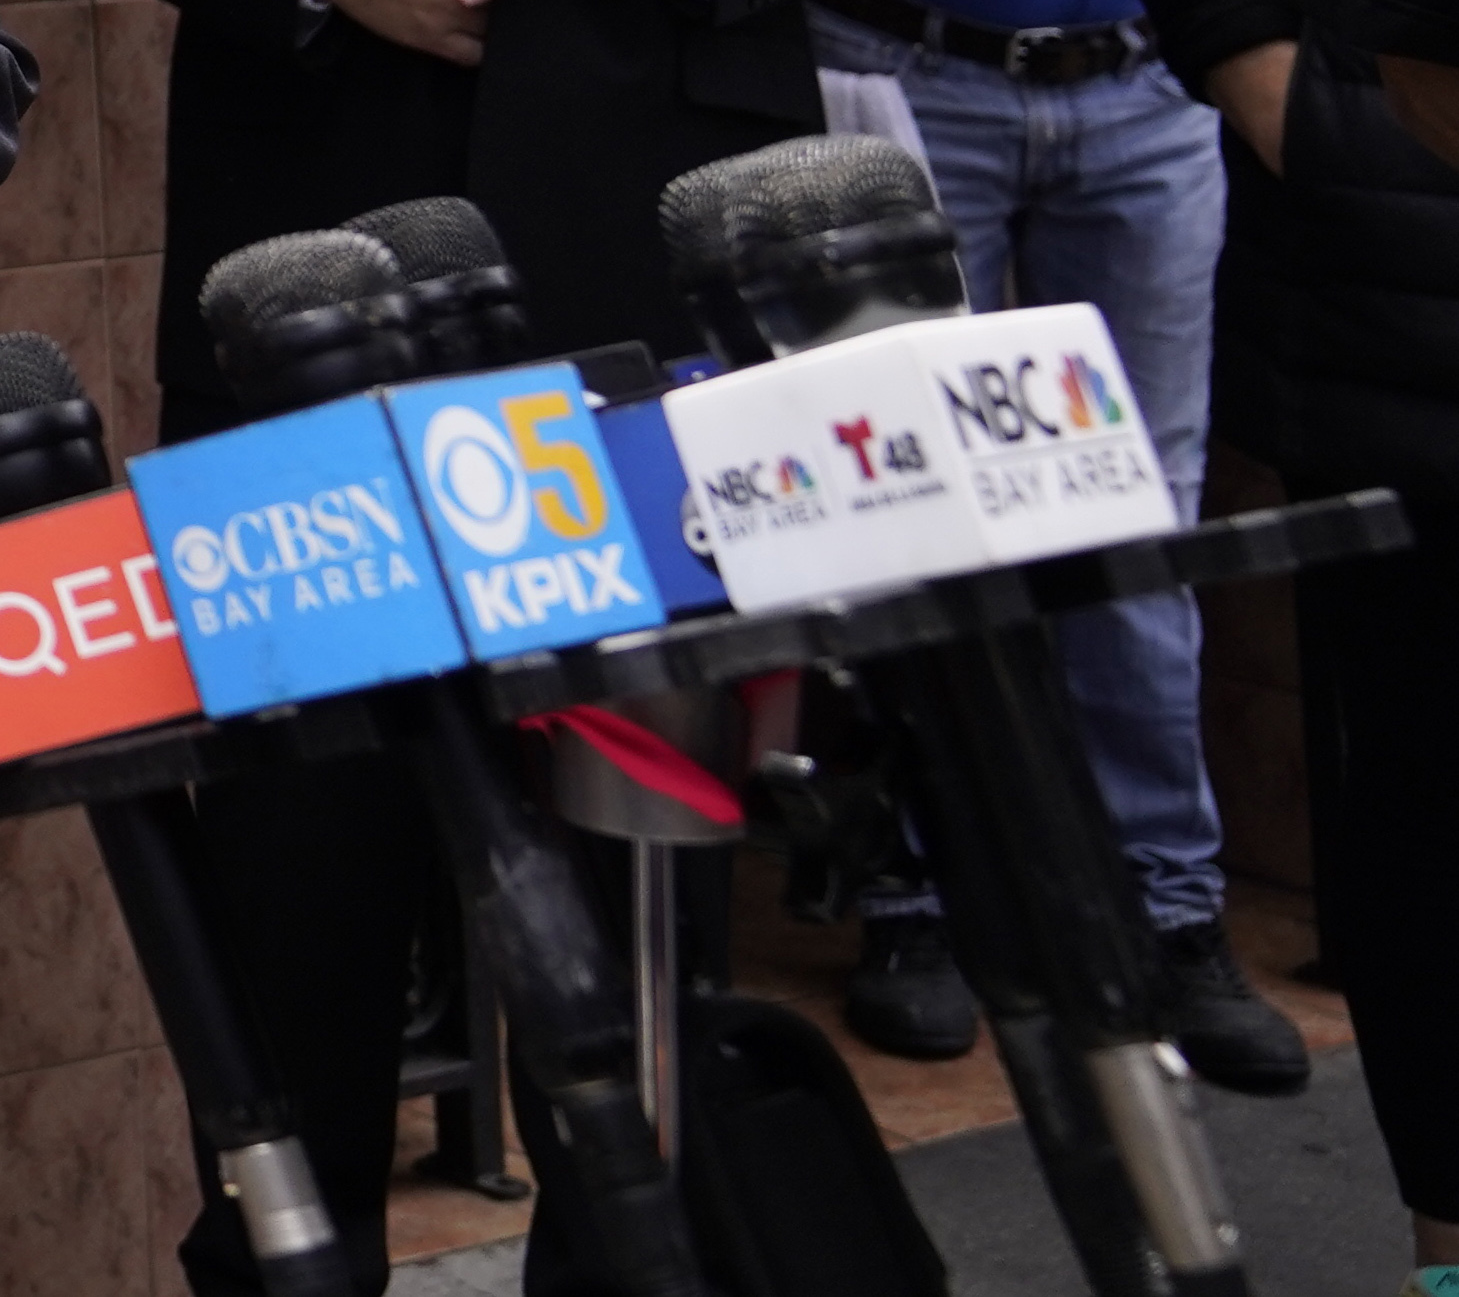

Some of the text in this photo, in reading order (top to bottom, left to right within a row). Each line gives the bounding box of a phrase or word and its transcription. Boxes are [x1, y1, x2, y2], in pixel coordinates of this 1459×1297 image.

[936, 356, 1061, 452] NBC
[501, 390, 607, 540] 5
[703, 461, 775, 506] NBC
[975, 461, 1046, 518] BAY
[1054, 447, 1151, 505] AREA
[225, 477, 406, 582] CBSN
[190, 552, 420, 637] BAY AREA
[464, 542, 645, 633] KPIX
